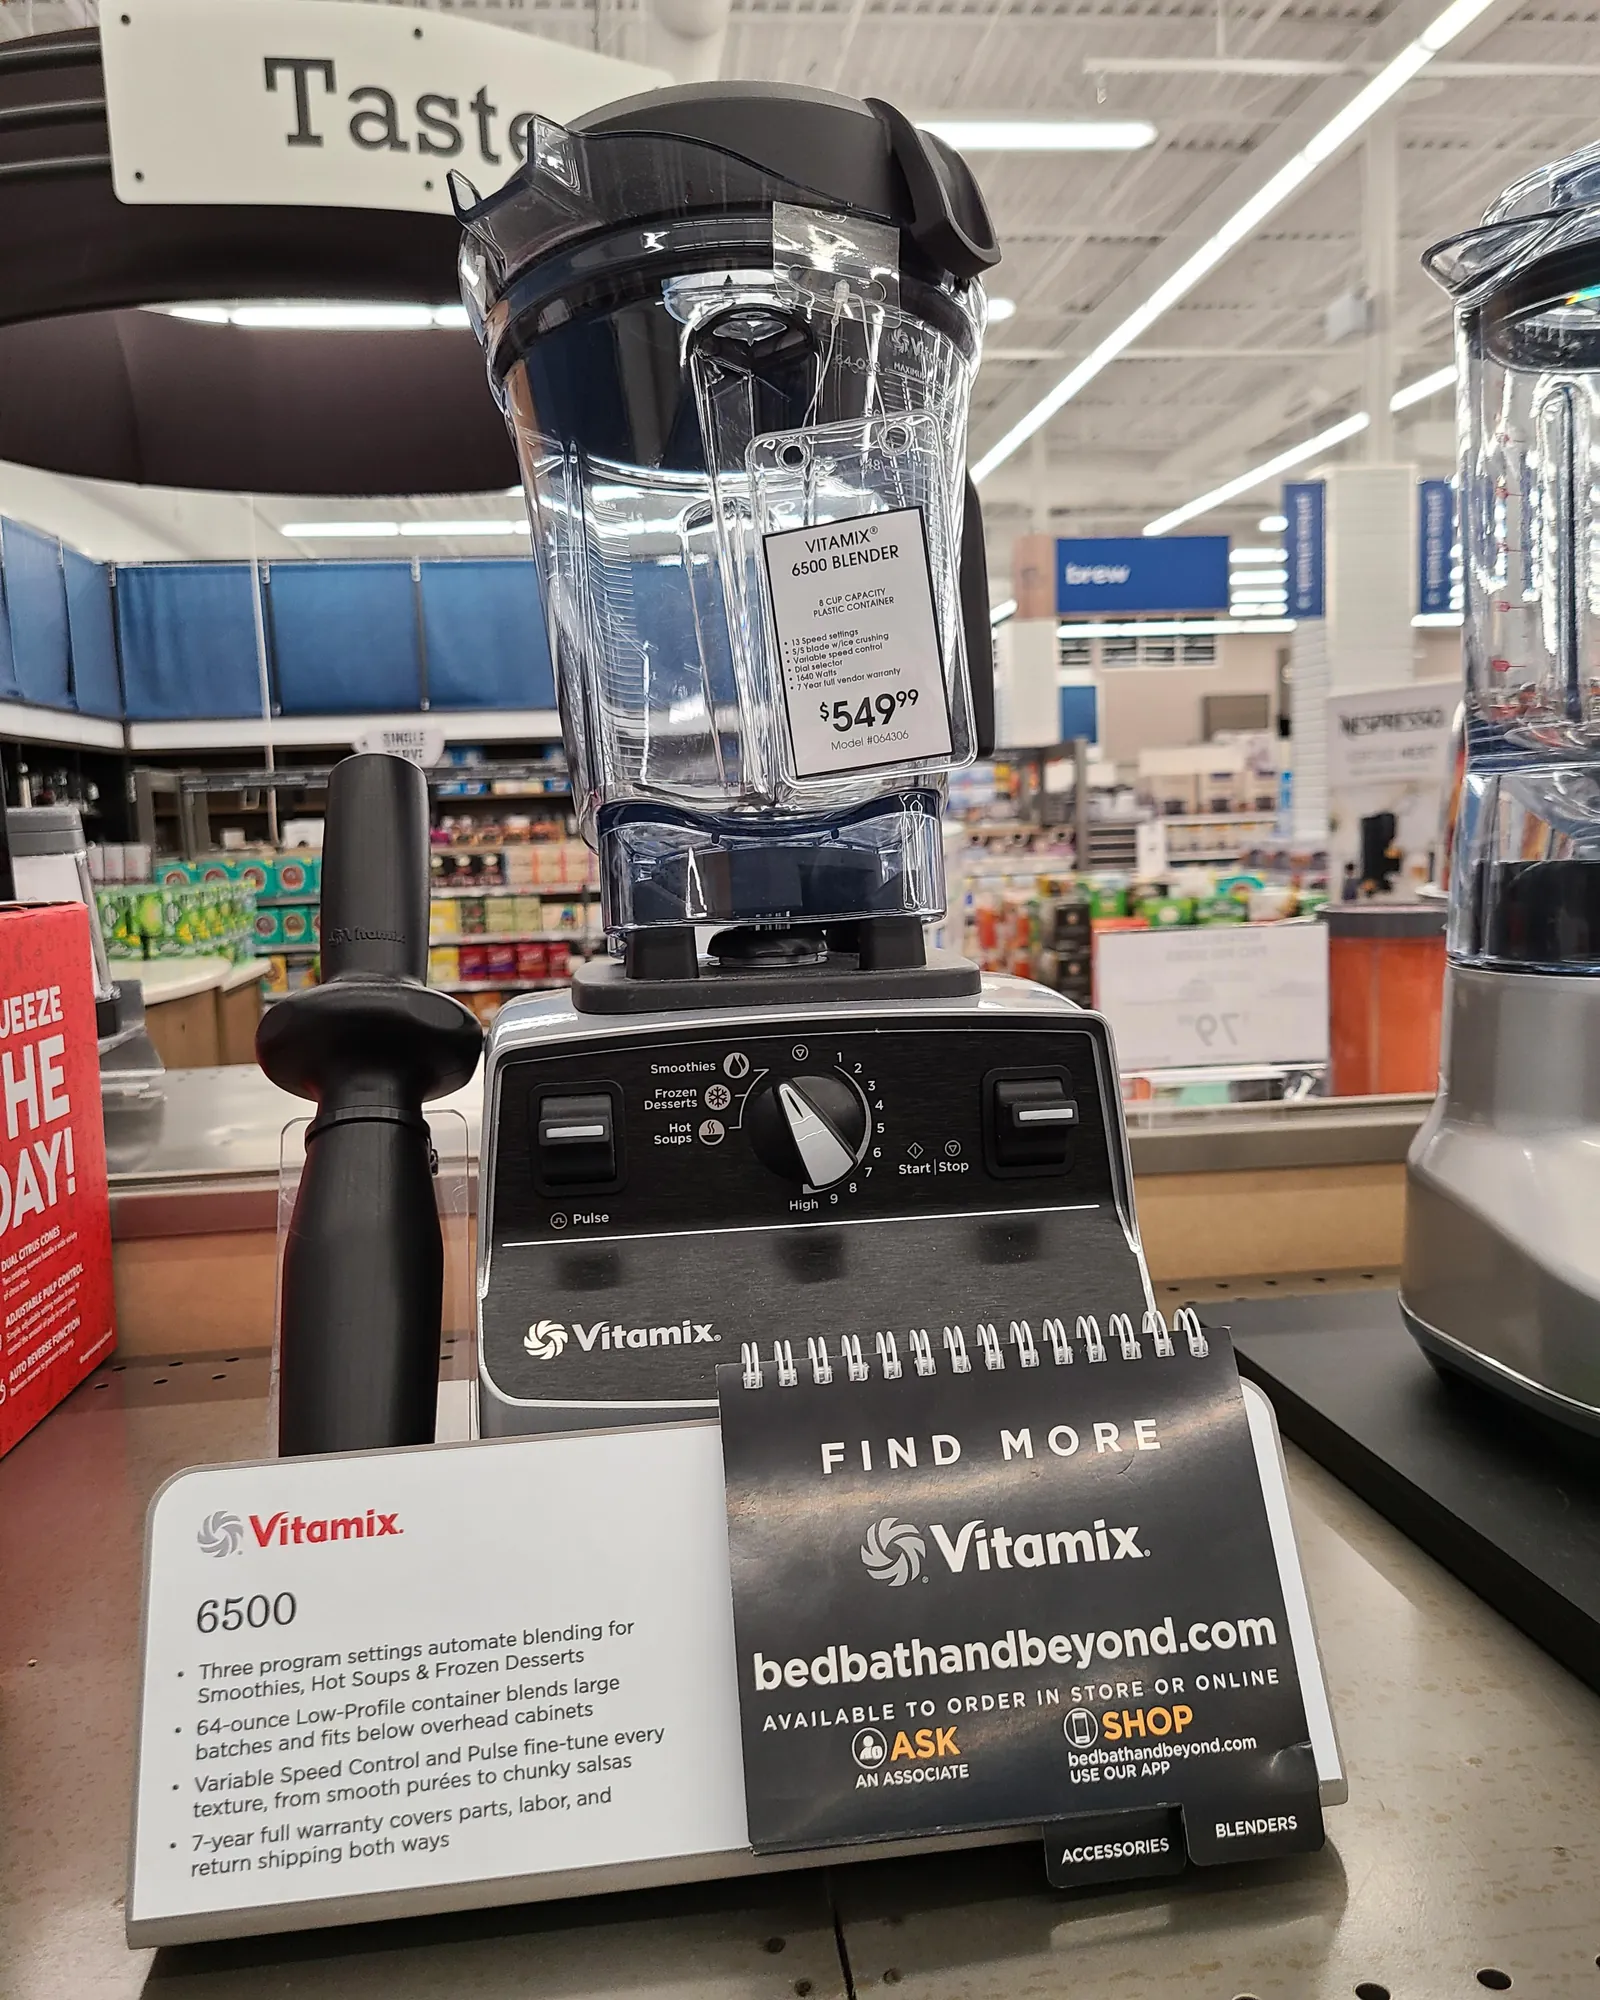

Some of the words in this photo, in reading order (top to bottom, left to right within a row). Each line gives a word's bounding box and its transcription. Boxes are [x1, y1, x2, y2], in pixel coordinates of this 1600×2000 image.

[792, 558, 827, 576] 6500
[832, 544, 899, 570] BLENDER
[1065, 562, 1132, 585] brew
[813, 605, 845, 618] PLASTIC
[846, 596, 894, 612] CONTAINER
[818, 599, 824, 607] 8
[826, 596, 842, 606] CUP
[845, 588, 886, 602] CAPACITY
[792, 638, 800, 646] 13
[802, 634, 827, 646] Speed
[829, 630, 858, 640] settings
[792, 647, 804, 656] S/S
[806, 642, 830, 653] blade
[832, 640, 854, 650] w/ice
[856, 633, 889, 645] crushing
[793, 652, 826, 665] Variable
[828, 648, 854, 660] speed
[855, 643, 882, 654] control
[794, 664, 810, 674] Dial
[812, 660, 842, 671] selector
[796, 673, 814, 682] 1640
[816, 670, 837, 679] Watts
[804, 681, 822, 690] Year
[824, 678, 836, 687] full
[837, 674, 864, 684] vendor
[866, 668, 901, 680] warranty
[831, 738, 864, 751] Model
[867, 730, 909, 745] #064306
[650, 1062, 716, 1074] Smoothies
[836, 1052, 842, 1062] 1
[854, 1062, 862, 1074] 2
[0, 1034, 71, 1140] HE
[655, 1088, 697, 1098] Frozen
[868, 1080, 876, 1091] 3
[644, 1098, 698, 1110] Desserts
[875, 1100, 884, 1110] 4
[669, 1122, 692, 1133] Hot
[876, 1122, 884, 1134] 5
[654, 1134, 692, 1145] Soups
[873, 1147, 882, 1158] 6
[864, 1167, 872, 1178] 7
[830, 1194, 838, 1204] 9
[849, 1182, 857, 1193] 8
[789, 1200, 818, 1212] High
[572, 1212, 610, 1225] Pulse
[58, 1262, 84, 1288] CONTROL
[572, 1320, 715, 1352] Vitamix
[10, 1362, 28, 1384] AUTO
[28, 1338, 52, 1367] REVERSE
[52, 1316, 81, 1347] FUNCTION
[821, 1434, 962, 1474] FIND
[1000, 1418, 1162, 1462] MORE
[249, 1509, 399, 1548] Vitamix
[930, 1518, 1143, 1573] Vitamix
[197, 1592, 297, 1634] 6500
[200, 1661, 253, 1680] Three
[260, 1652, 342, 1676] program
[348, 1643, 422, 1664] settings
[428, 1634, 516, 1656] automate
[523, 1624, 602, 1646] blending
[608, 1620, 635, 1636] for
[753, 1615, 1277, 1691] bedbathandbeyond.com
[198, 1680, 305, 1704] Smoothies,
[312, 1674, 346, 1692] Hot
[352, 1668, 410, 1687] Soups
[416, 1664, 429, 1680] &
[436, 1659, 498, 1678] Frozen
[506, 1648, 584, 1670] Desserts
[197, 1712, 290, 1736] 64-ounce
[297, 1698, 405, 1725] Low-Profile
[412, 1690, 500, 1712] container
[507, 1682, 568, 1702] blends
[574, 1677, 620, 1695] large
[762, 1704, 895, 1732] AVAILABLE
[906, 1700, 935, 1718] TO
[948, 1691, 1026, 1715] ORDER
[1038, 1688, 1059, 1706] IN
[1071, 1681, 1144, 1704] STORE
[1154, 1677, 1185, 1696] OR
[1196, 1668, 1280, 1692] ONLINE
[196, 1738, 272, 1760] batches
[279, 1731, 315, 1750] and
[322, 1730, 350, 1746] fits
[358, 1722, 414, 1742] below
[421, 1710, 508, 1735] overhead
[515, 1702, 593, 1724] cabinets
[1102, 1705, 1194, 1740] SHOP
[890, 1726, 961, 1762] ASK
[1068, 1735, 1257, 1768] bedbathandbeyond.com
[194, 1770, 274, 1793] Variable
[280, 1760, 342, 1784] Speed
[350, 1752, 419, 1775] Control
[426, 1747, 461, 1766] and
[468, 1742, 518, 1762] Pulse
[524, 1734, 609, 1756] fine-tune
[614, 1727, 665, 1746] every
[855, 1774, 880, 1790] AN
[883, 1764, 970, 1787] ASSOCIATE
[1070, 1769, 1100, 1784] USE
[1104, 1764, 1137, 1782] OUR
[1141, 1760, 1170, 1778] APP
[194, 1797, 268, 1818] texture,
[275, 1792, 320, 1809] from
[327, 1778, 400, 1802] smooth
[407, 1772, 471, 1798] purées
[478, 1770, 497, 1785] to
[503, 1760, 571, 1783] chunky
[577, 1755, 632, 1773] salsas
[192, 1830, 254, 1852] 7-year
[261, 1824, 290, 1844] full
[297, 1815, 384, 1840] warranty
[390, 1808, 452, 1828] covers
[459, 1800, 513, 1824] parts,
[519, 1794, 571, 1814] labor,
[577, 1786, 612, 1807] and
[1216, 1816, 1298, 1838] BLENDERS
[191, 1857, 252, 1877] return
[258, 1846, 342, 1870] shipping
[350, 1838, 394, 1859] both
[401, 1834, 450, 1852] ways
[1062, 1837, 1170, 1865] ACCESSORIES
